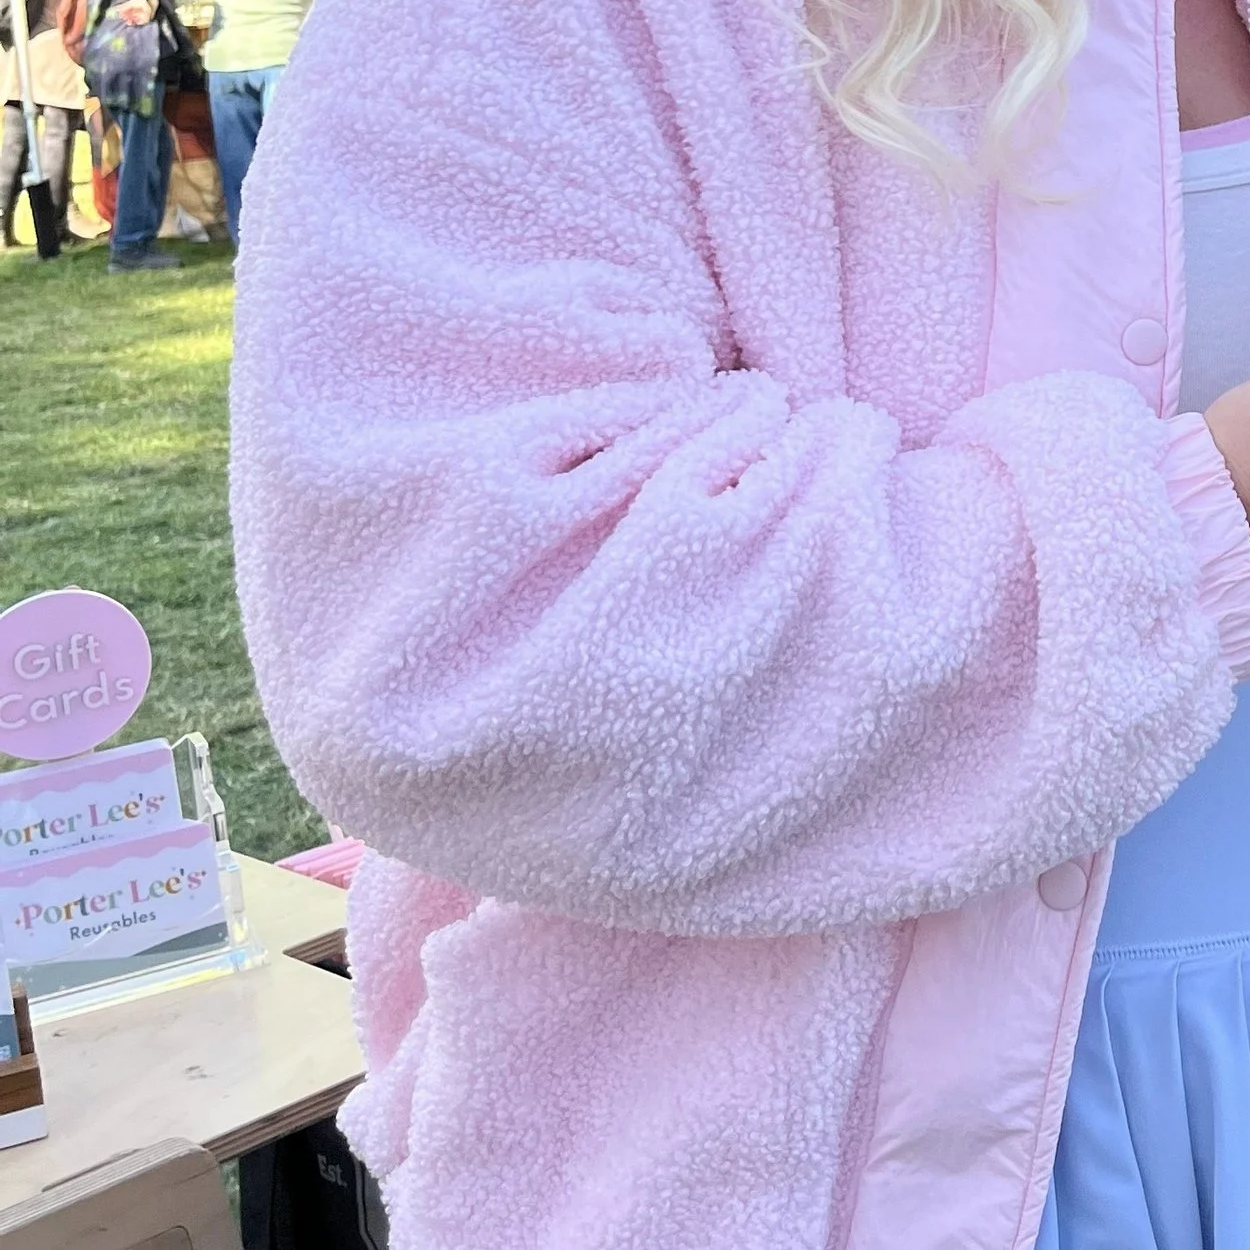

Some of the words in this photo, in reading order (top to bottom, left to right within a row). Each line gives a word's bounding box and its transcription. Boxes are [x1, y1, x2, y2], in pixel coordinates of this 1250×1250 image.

[13, 633, 101, 680] Gift
[0, 671, 135, 730] Cards
[0, 813, 82, 847] orter
[88, 792, 161, 828] Lee's
[20, 893, 123, 930] Porter
[129, 867, 202, 905] Lee's
